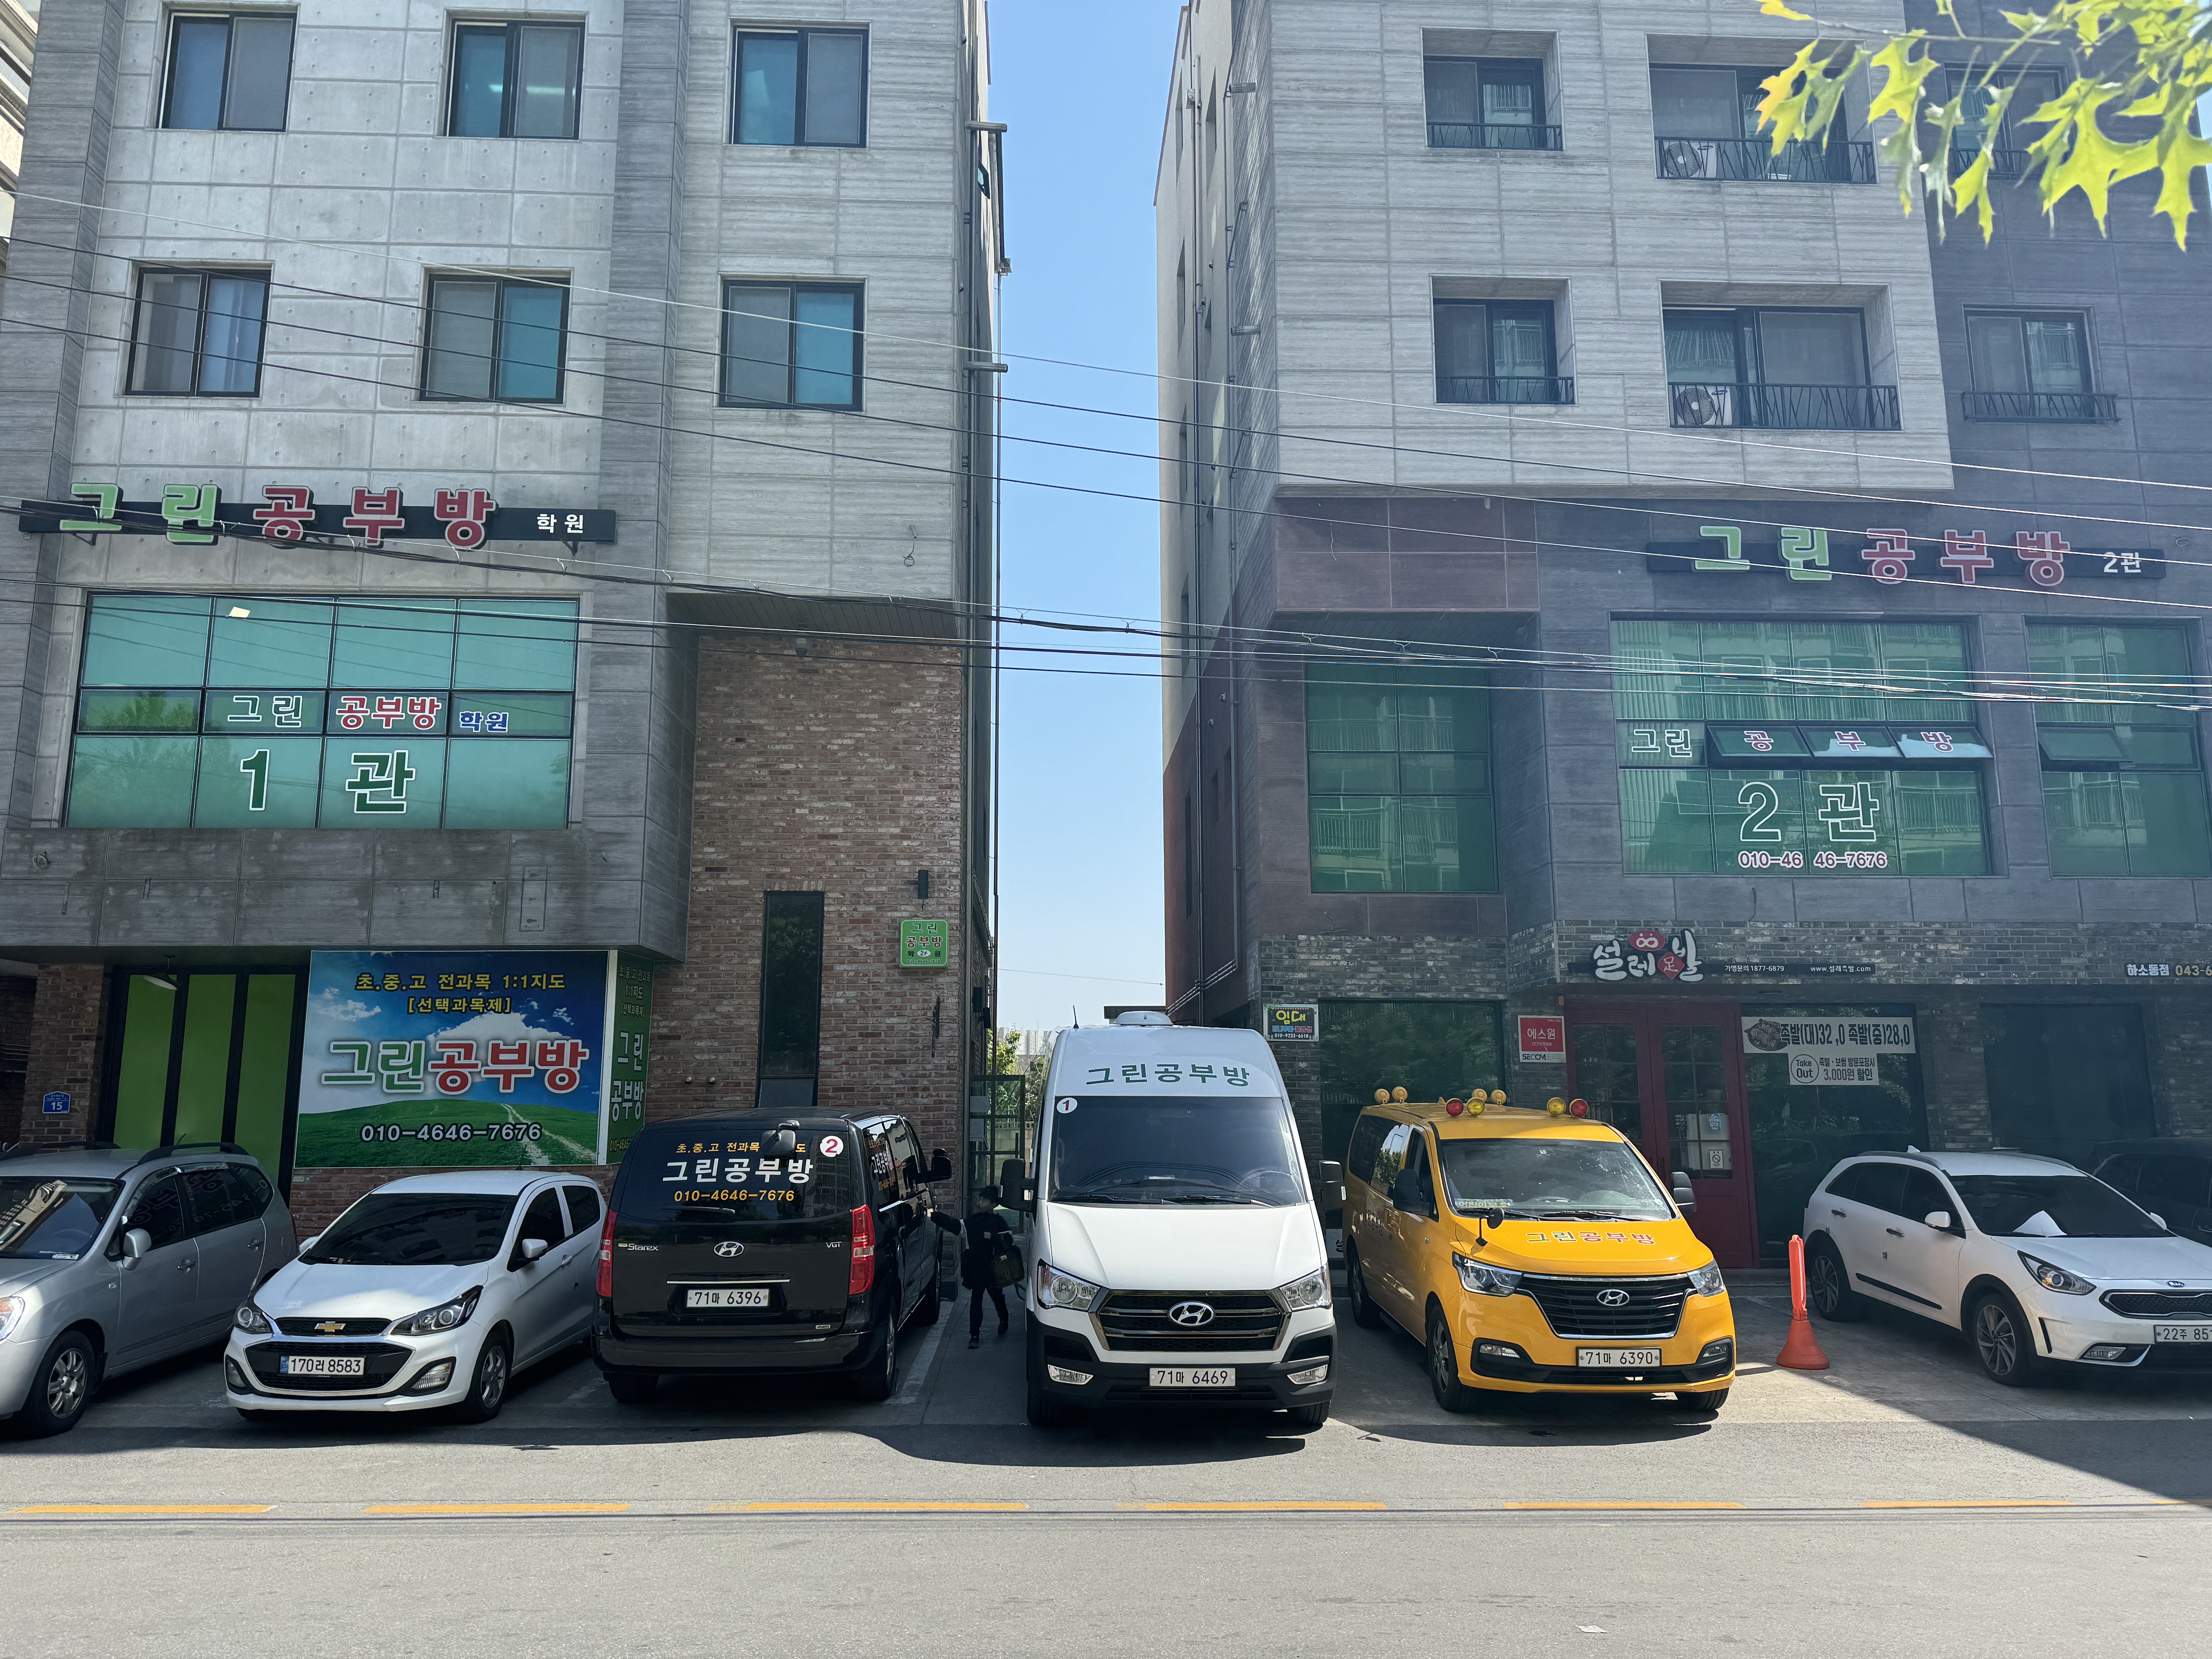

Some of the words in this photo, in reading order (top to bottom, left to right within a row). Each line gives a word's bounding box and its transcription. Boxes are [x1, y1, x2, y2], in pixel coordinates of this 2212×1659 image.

[537, 513, 584, 534] 학원
[2104, 552, 2142, 574] 2관
[228, 695, 302, 728] 그린
[336, 696, 441, 730] 공부방
[459, 711, 509, 732] 학원
[1631, 728, 1692, 758] 그린
[911, 923, 937, 934] 그린
[905, 936, 943, 948] 공부방
[2127, 964, 2169, 976] 하소동점
[357, 974, 426, 990] 초.중.고
[439, 974, 491, 990] 전과목
[503, 974, 565, 989] 1:1지도
[626, 984, 642, 999] 1:1지도
[409, 998, 510, 1013] [선택과목제]
[1276, 1010, 1305, 1025] 임대
[1527, 1029, 1555, 1039] 에스원
[617, 1032, 643, 1071] 그린
[321, 1039, 589, 1095] 그린공부방
[1848, 1058, 1875, 1066] 방문포장시
[1796, 1068, 1813, 1078] Out
[1824, 1068, 1855, 1081] 3,000원
[1857, 1068, 1872, 1081] 할인
[51, 1102, 62, 1110] 15
[611, 1080, 644, 1121] 공부방
[1063, 1100, 1070, 1111] 1
[361, 1124, 541, 1141] 010-4646-7676
[610, 1139, 630, 1151] 010-4646-
[676, 1143, 719, 1153] 초.중.고
[727, 1142, 759, 1152] 전과목
[825, 1139, 837, 1154] 2
[663, 1158, 813, 1183] 그린공부방
[675, 1190, 794, 1202] 010-4646-7676
[1526, 1231, 1656, 1245] 그린공부방
[695, 1291, 720, 1305] 71마
[727, 1291, 761, 1304] 6396
[2164, 1328, 2187, 1340] 22주
[2194, 1328, 2212, 1340] 85
[1586, 1352, 1611, 1364] 71마
[1620, 1352, 1652, 1364] 6390
[291, 1358, 324, 1372] 170러
[328, 1359, 361, 1373] 8583
[1158, 1370, 1184, 1384] 71마
[1192, 1370, 1228, 1384] 6469
